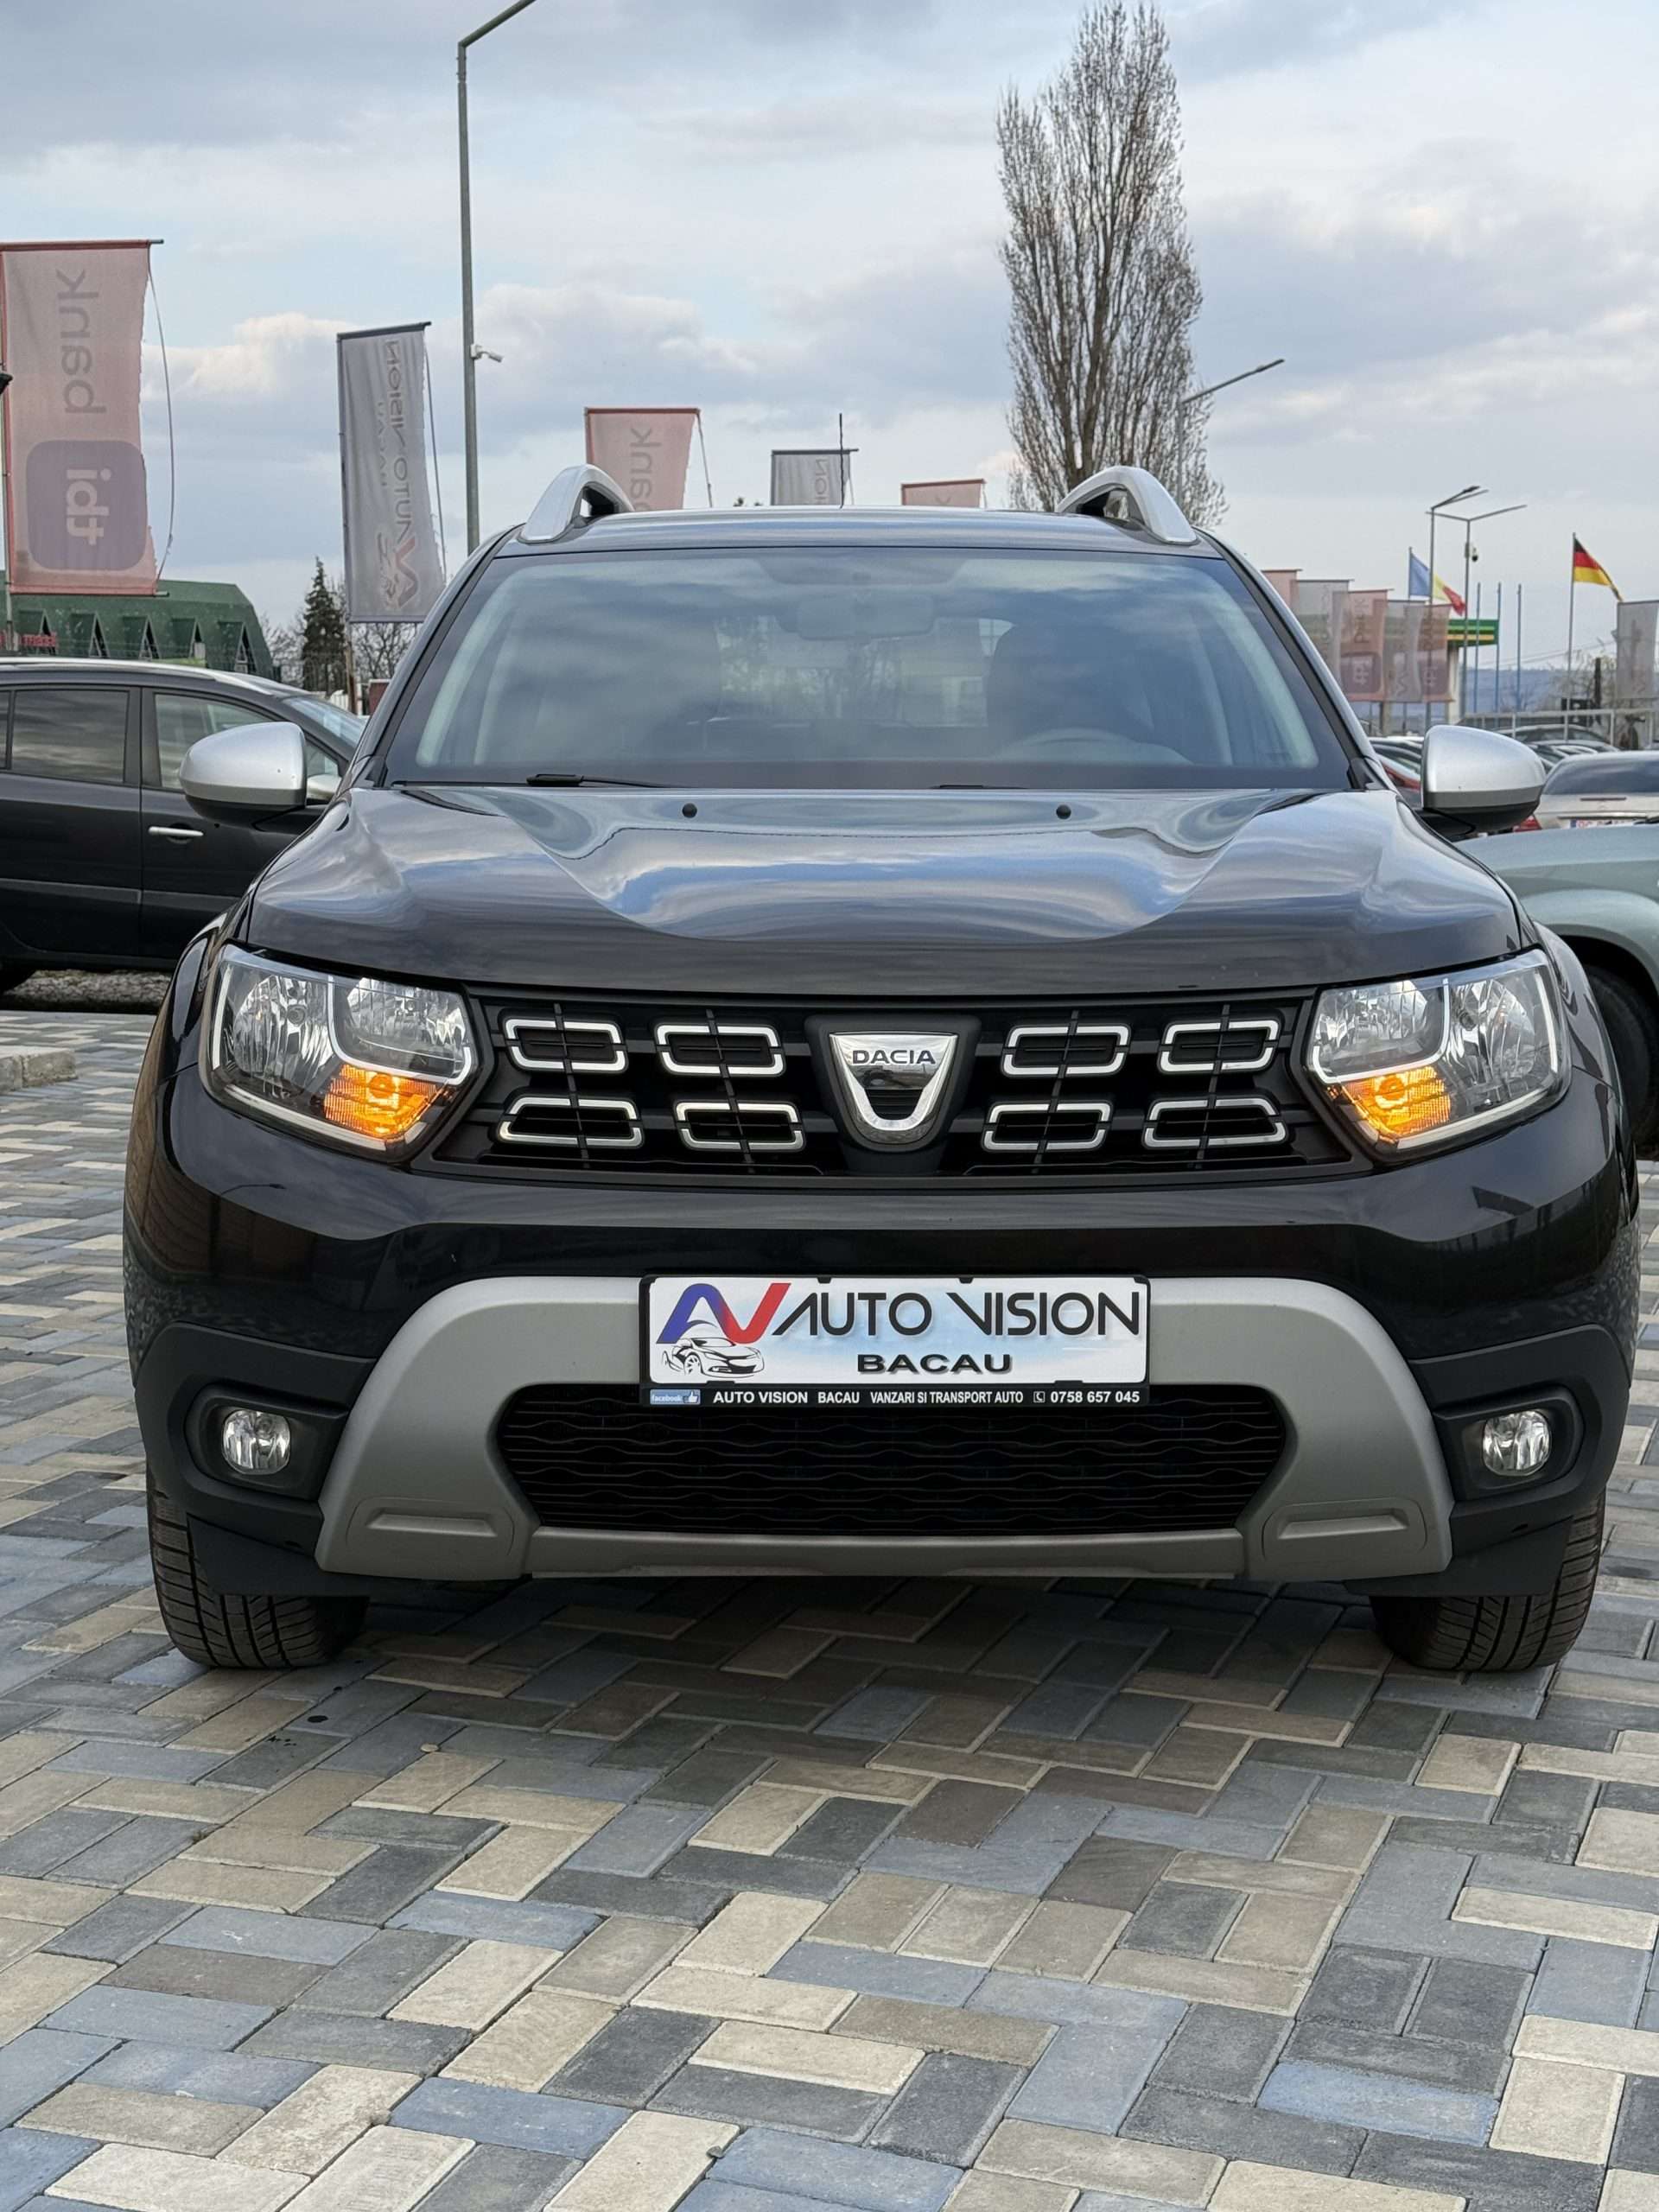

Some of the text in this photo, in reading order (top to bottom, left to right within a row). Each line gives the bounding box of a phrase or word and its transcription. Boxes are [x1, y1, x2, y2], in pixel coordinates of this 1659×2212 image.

[852, 1050, 936, 1065] DACIA
[772, 1293, 932, 1336] AUTO
[946, 1293, 1140, 1336] VISION
[856, 1354, 1014, 1374] BACAU
[713, 1391, 755, 1404] AUTO
[758, 1391, 809, 1404] VISION
[817, 1391, 860, 1404] BACAU
[869, 1391, 915, 1404] VANZARI
[917, 1391, 928, 1404] SI
[929, 1391, 993, 1404] TRANSPORT
[994, 1391, 1024, 1404] AUTO
[1050, 1391, 1084, 1403] 0758
[1086, 1391, 1112, 1403] 657
[1115, 1391, 1141, 1403] 045
